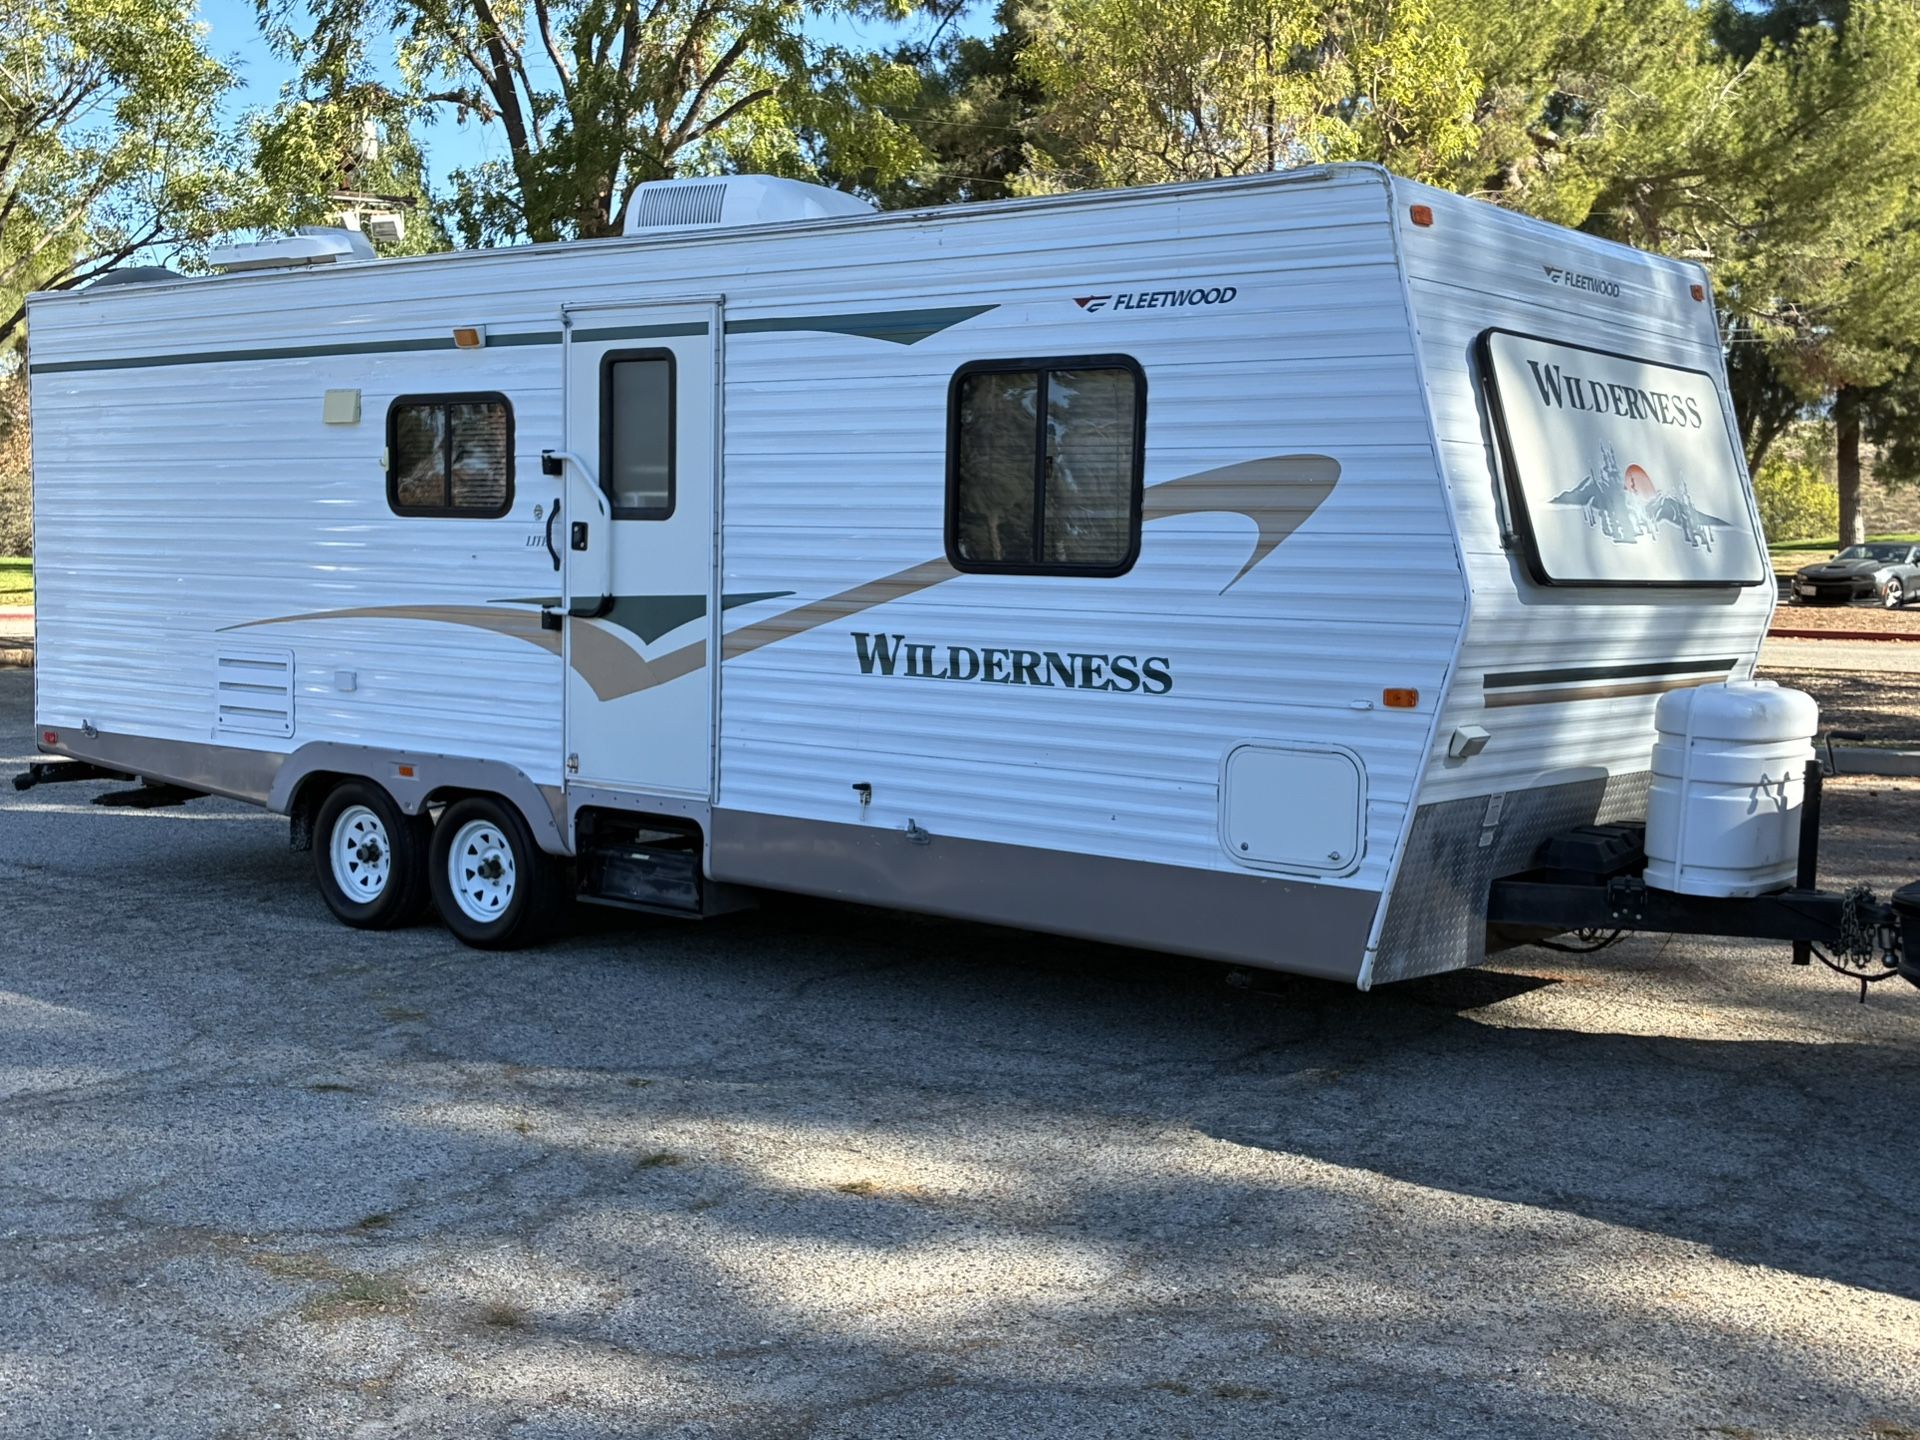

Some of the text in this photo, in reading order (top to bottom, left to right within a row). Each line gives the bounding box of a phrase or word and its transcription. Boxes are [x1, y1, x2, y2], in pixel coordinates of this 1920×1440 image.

[1113, 286, 1237, 311] FLEETWOOD
[1565, 271, 1620, 298] FLEETWOOD
[1526, 359, 1703, 429] WILDERNESS
[850, 631, 1173, 695] WILDERNESS
